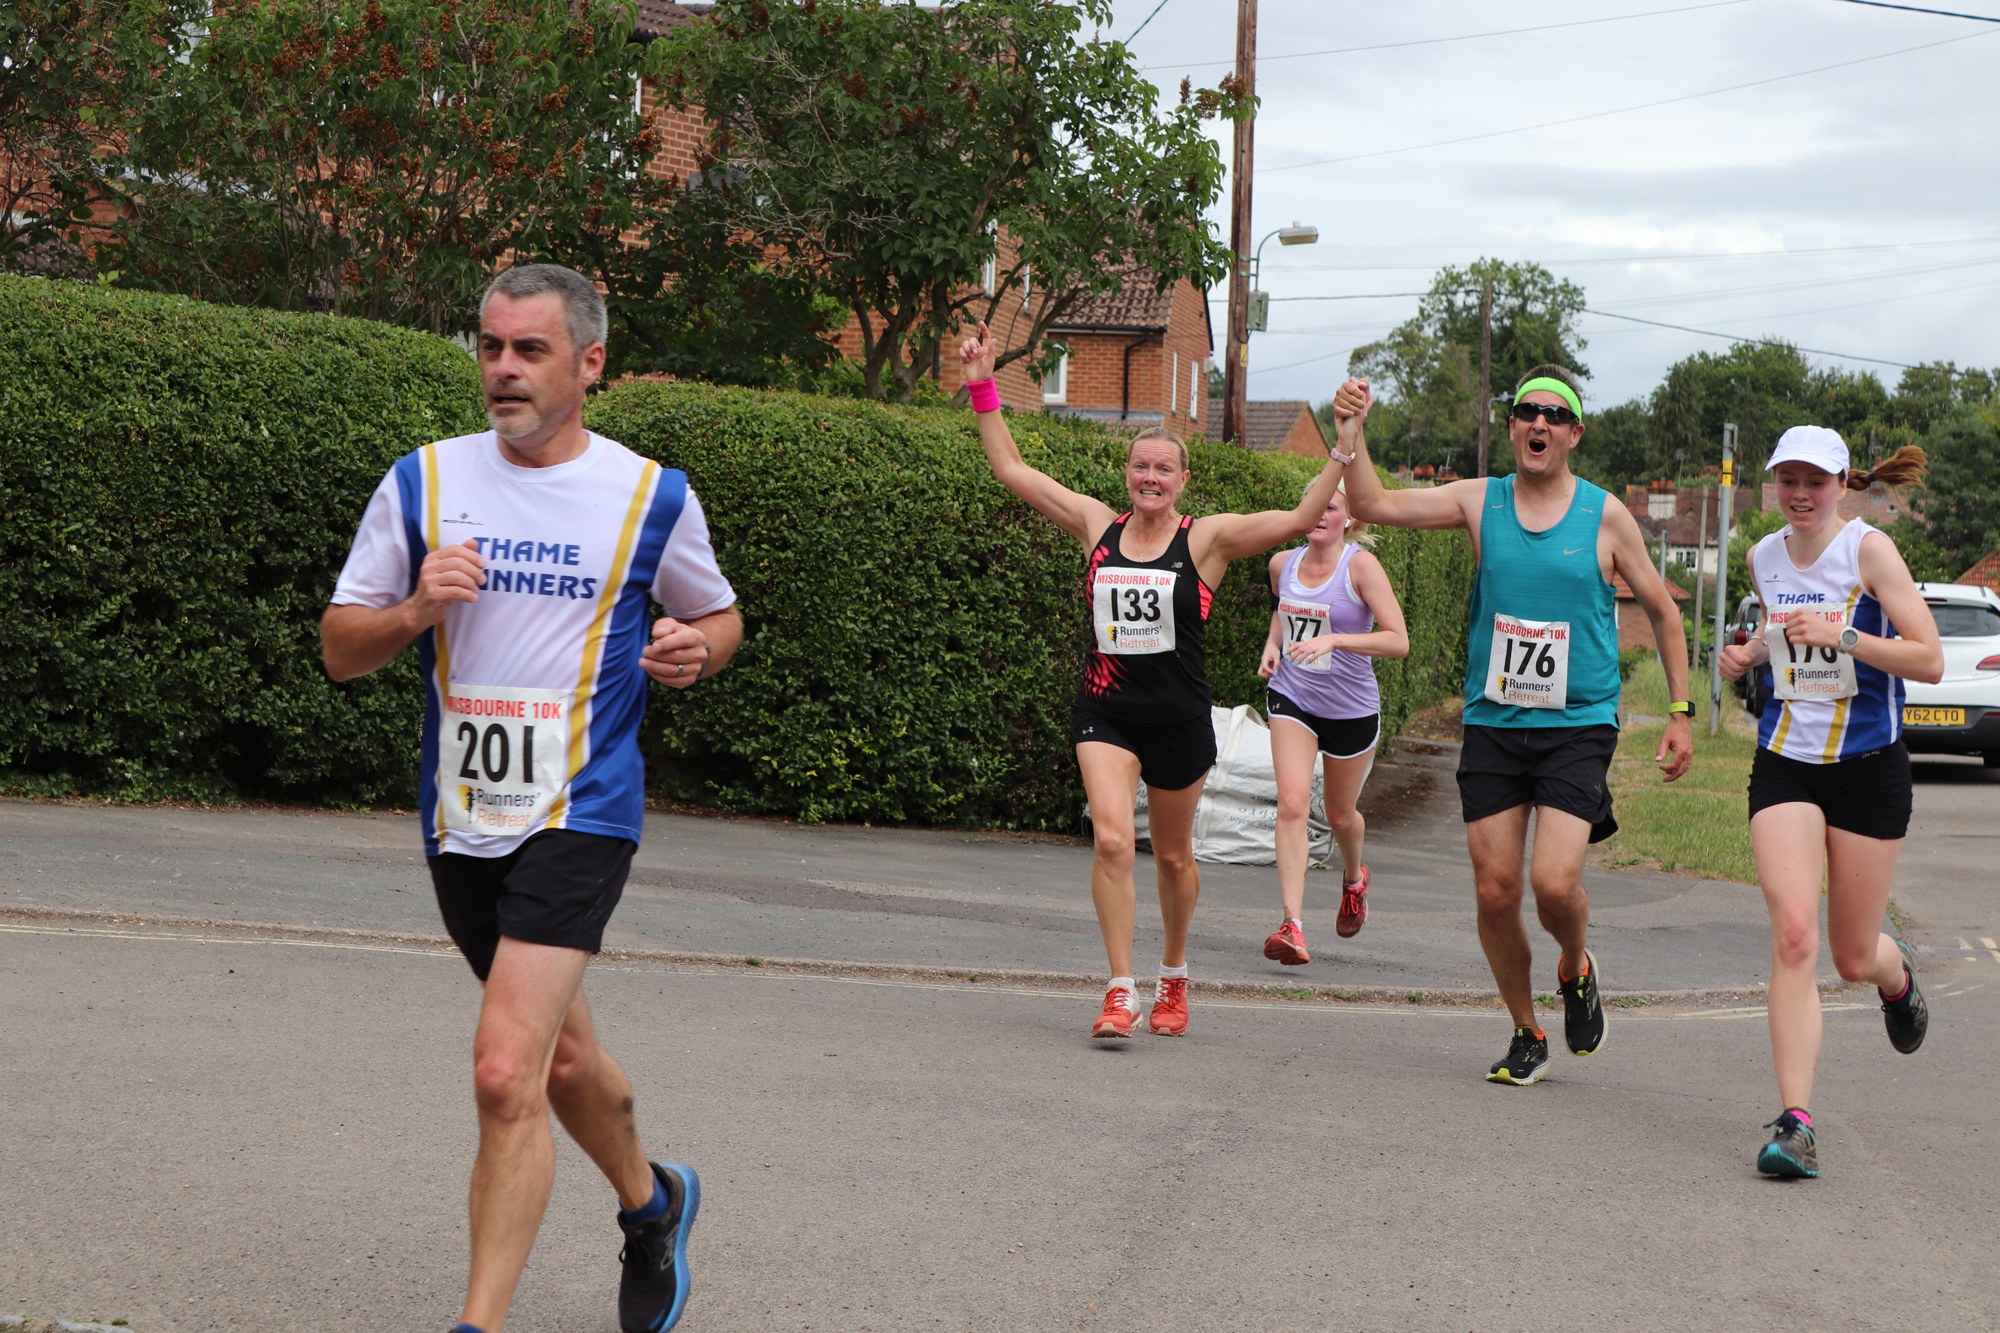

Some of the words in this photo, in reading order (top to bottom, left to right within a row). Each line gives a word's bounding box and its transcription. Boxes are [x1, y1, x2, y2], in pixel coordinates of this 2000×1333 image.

[473, 537, 581, 566] THAME
[478, 568, 597, 600] UNNERS
[1097, 574, 1151, 586] MISBOURNE
[1155, 576, 1172, 586] 10K
[1111, 588, 1161, 622] 133
[1315, 610, 1327, 618] 10K
[1825, 611, 1843, 623] 10K
[1120, 626, 1162, 636] Runners'
[1287, 615, 1322, 642] 177
[1495, 621, 1546, 640] MISBOURNE
[1549, 629, 1567, 640] 10K
[1120, 638, 1160, 649] Retreat
[1503, 638, 1556, 678] 176
[1509, 678, 1554, 693] Runners'
[1798, 681, 1841, 693] Retreat
[1508, 690, 1550, 704] Retreat
[532, 702, 562, 720] 10K
[1905, 708, 1930, 722] Y62
[457, 721, 535, 783] 201
[475, 808, 532, 828] Retreat
